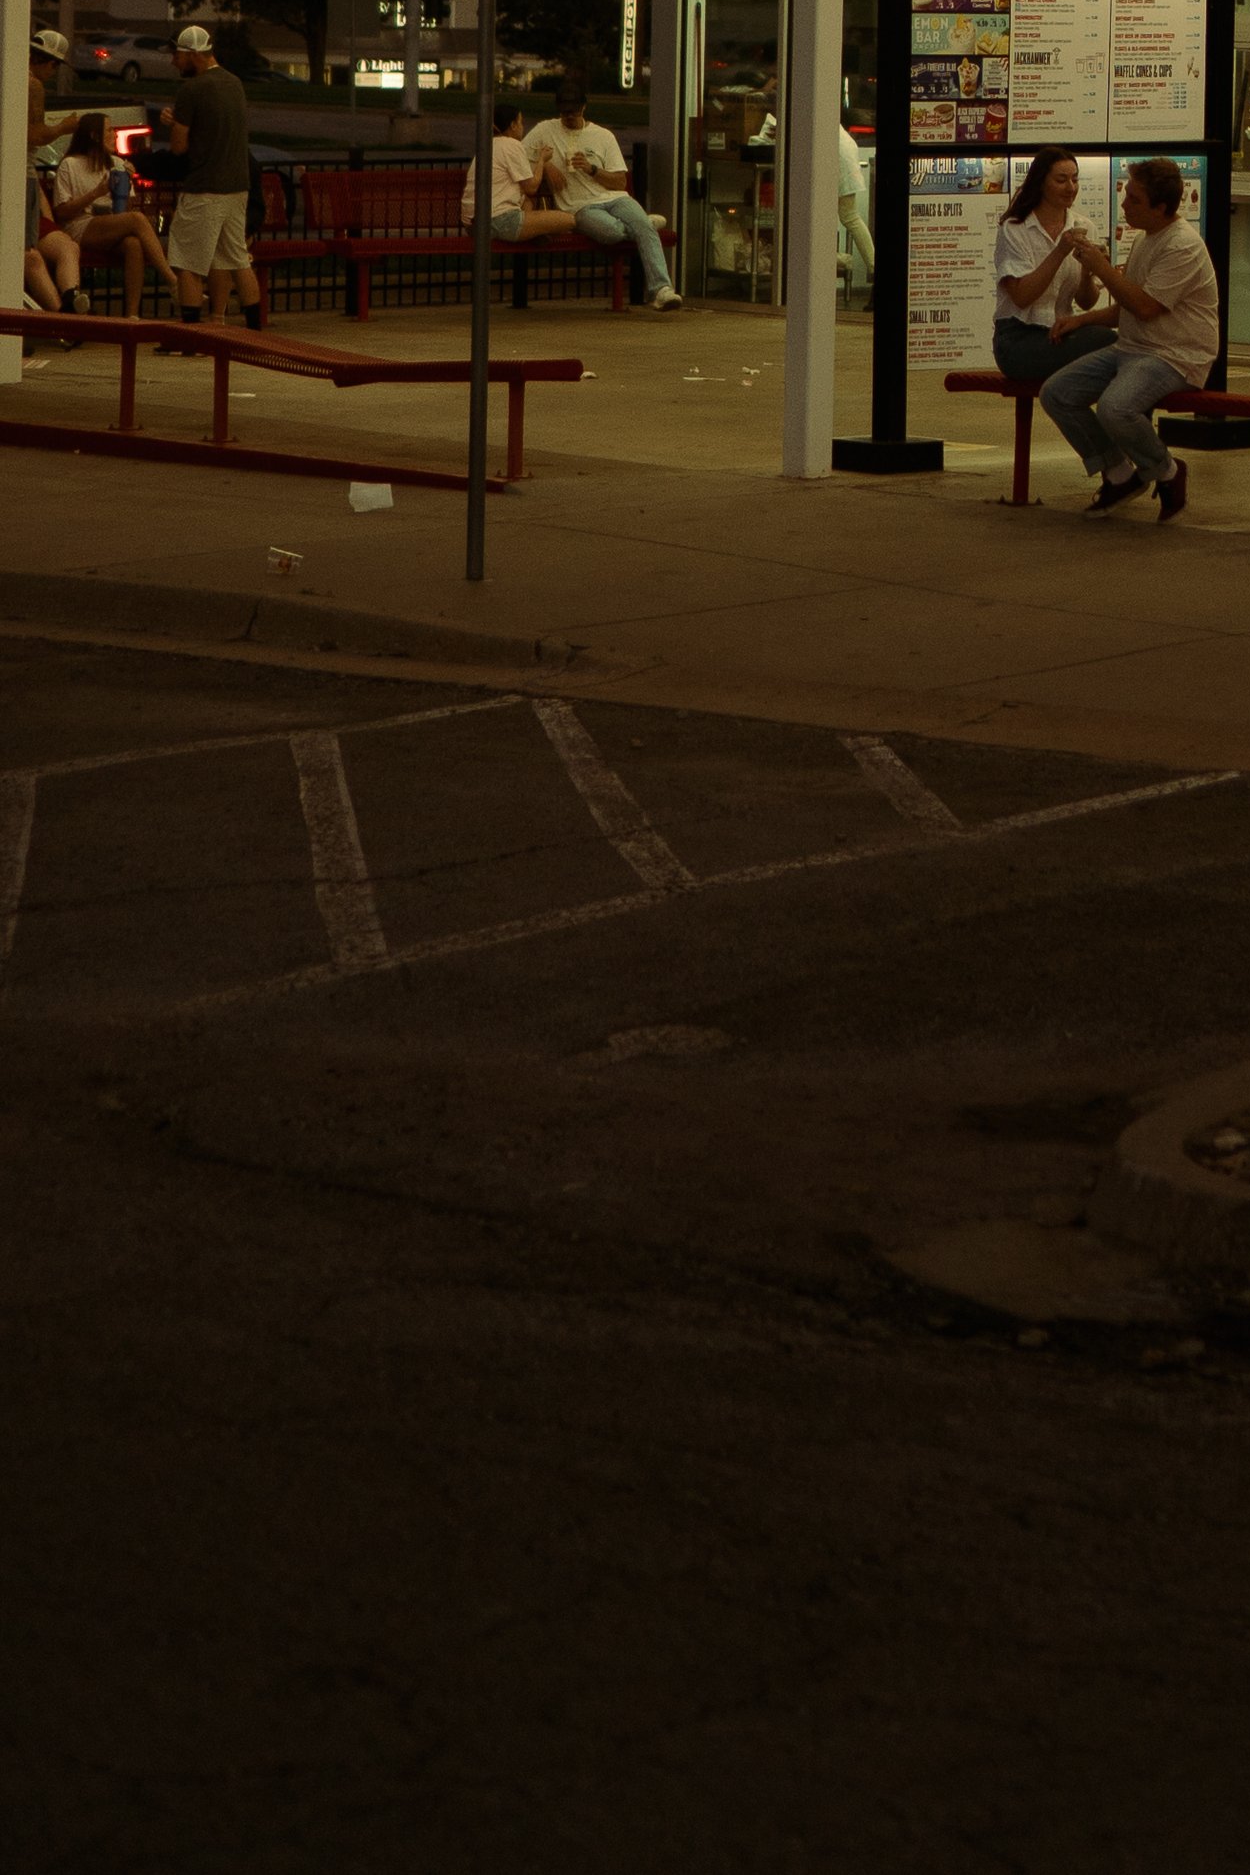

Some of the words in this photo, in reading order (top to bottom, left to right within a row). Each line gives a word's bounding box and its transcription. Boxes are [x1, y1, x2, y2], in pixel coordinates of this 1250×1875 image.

[916, 31, 941, 43] BAR
[1114, 65, 1135, 78] WAFFLE
[1135, 65, 1152, 78] CONES
[1153, 65, 1157, 78] &
[1158, 65, 1172, 78] CUPS
[911, 203, 936, 216] SUNDAES
[937, 203, 941, 216] &
[943, 203, 962, 216] SPLITS
[909, 310, 928, 323] SMALL
[929, 310, 950, 323] TREATS
